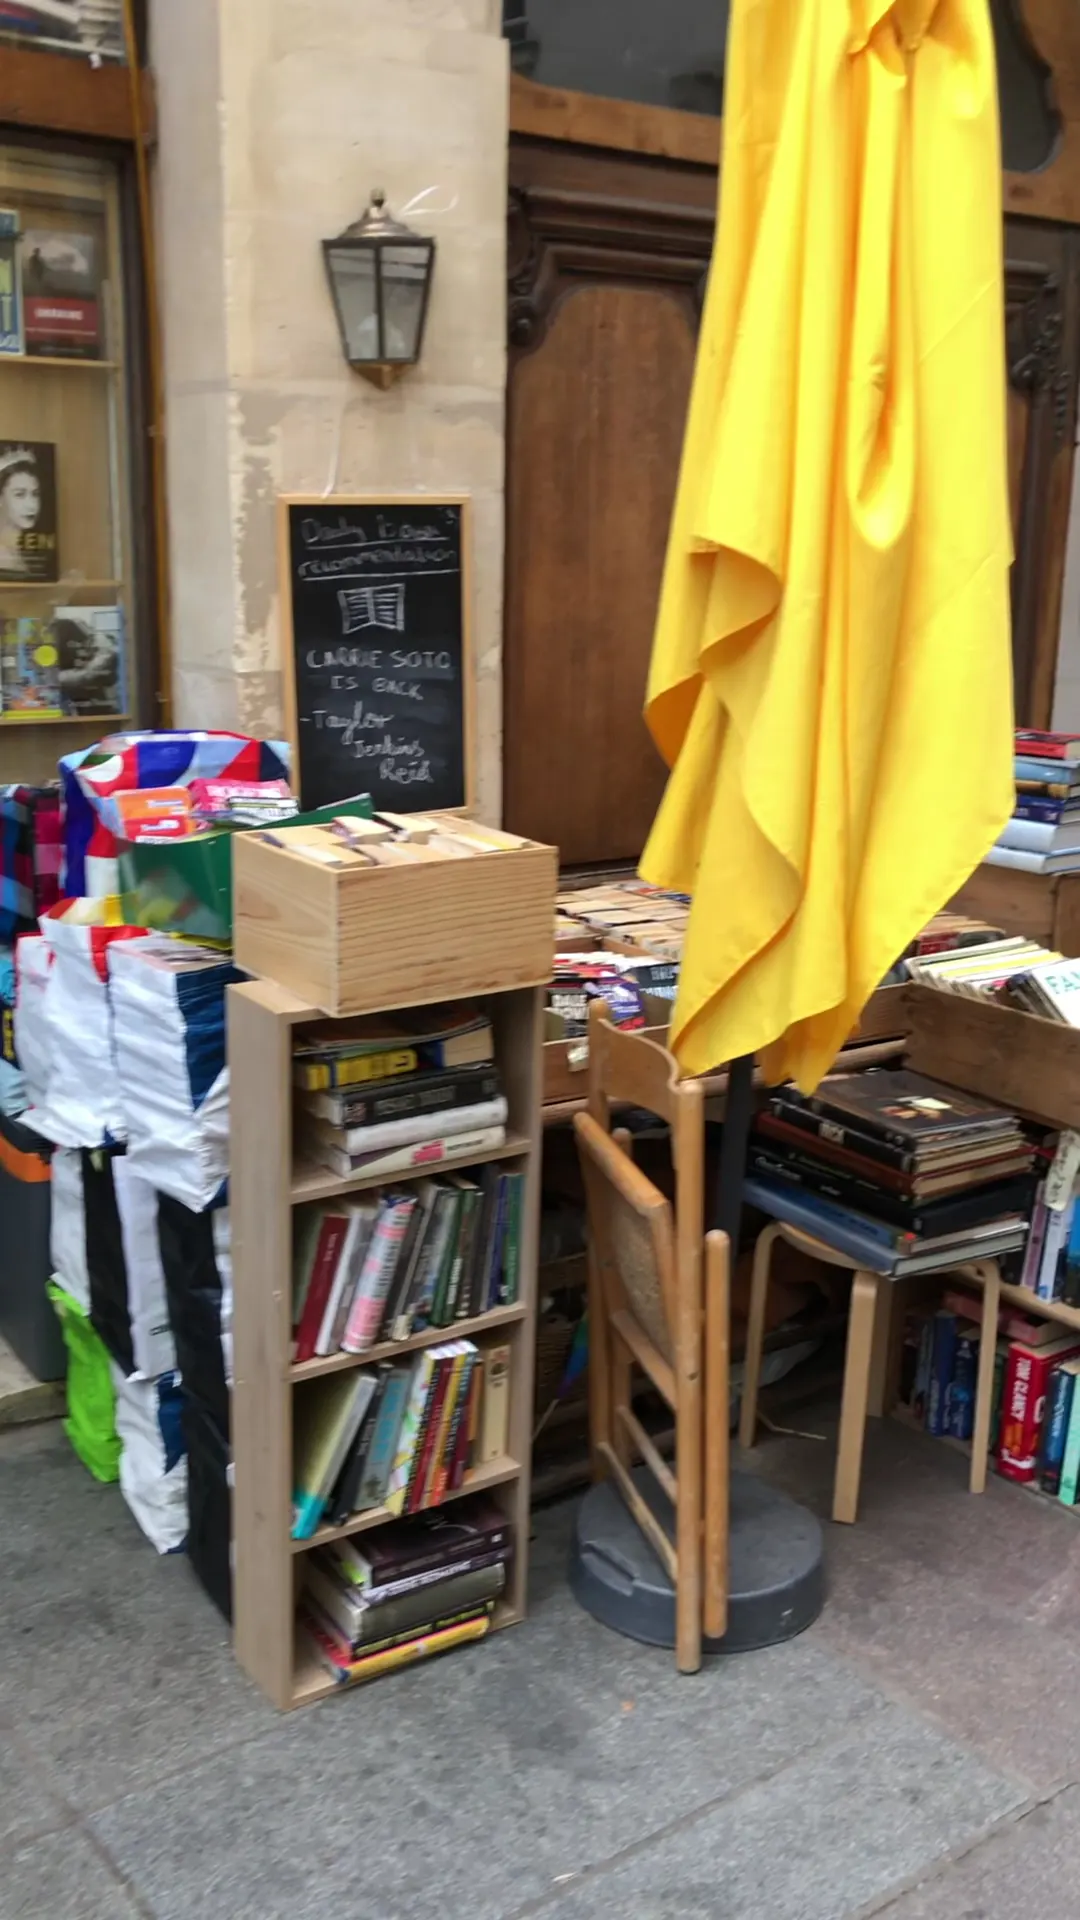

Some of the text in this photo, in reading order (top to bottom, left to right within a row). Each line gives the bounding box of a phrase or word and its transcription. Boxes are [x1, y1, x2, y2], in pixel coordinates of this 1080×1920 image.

[389, 650, 451, 669] SOTO
[330, 675, 424, 701] IS BACK
